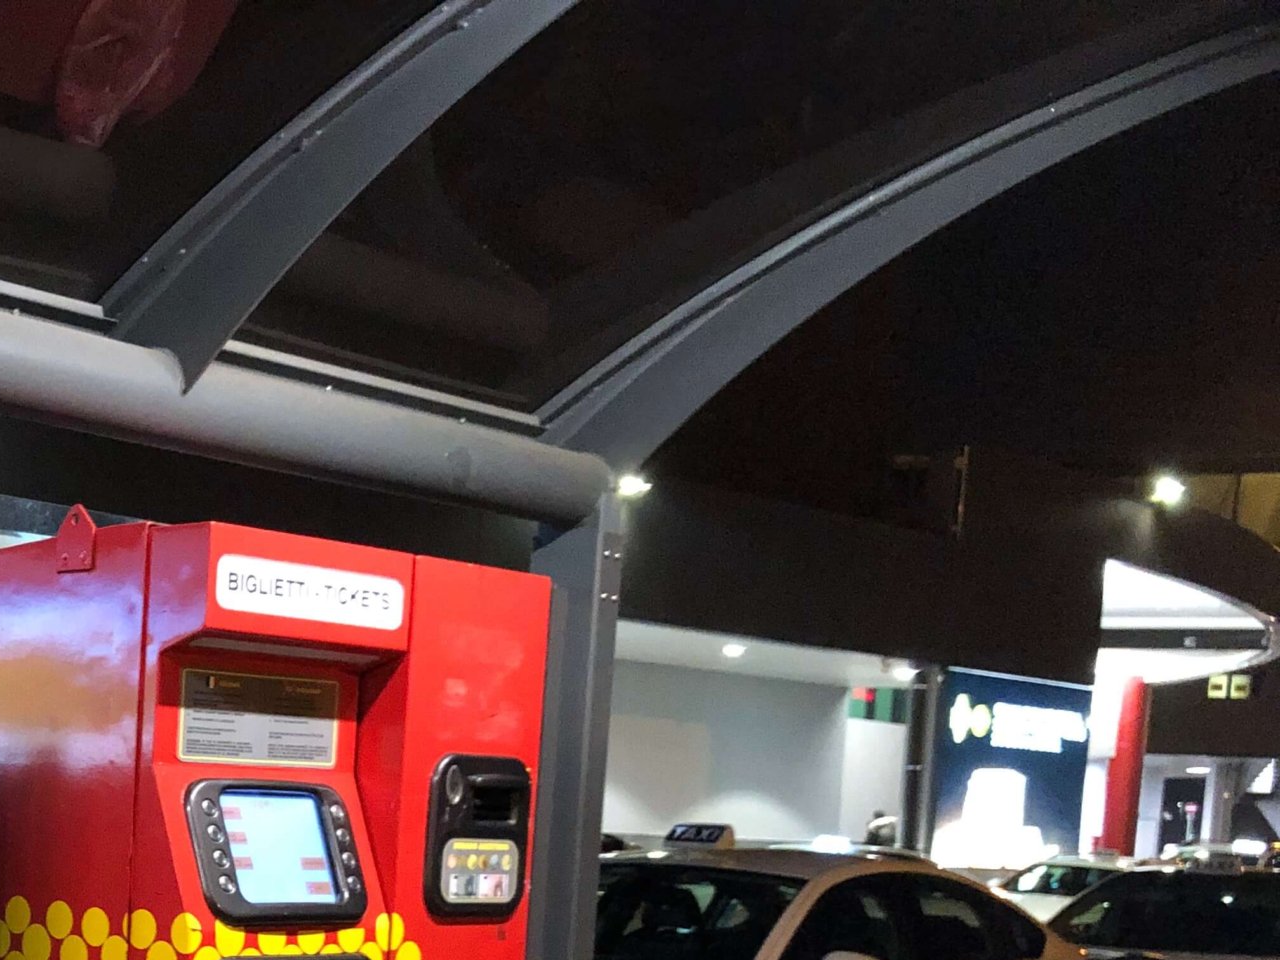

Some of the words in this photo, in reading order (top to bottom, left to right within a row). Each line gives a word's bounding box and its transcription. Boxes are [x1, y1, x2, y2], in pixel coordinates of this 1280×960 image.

[228, 572, 310, 599] BIGLIETTI
[324, 585, 390, 610] TICKETS
[672, 826, 719, 841] TAXI
